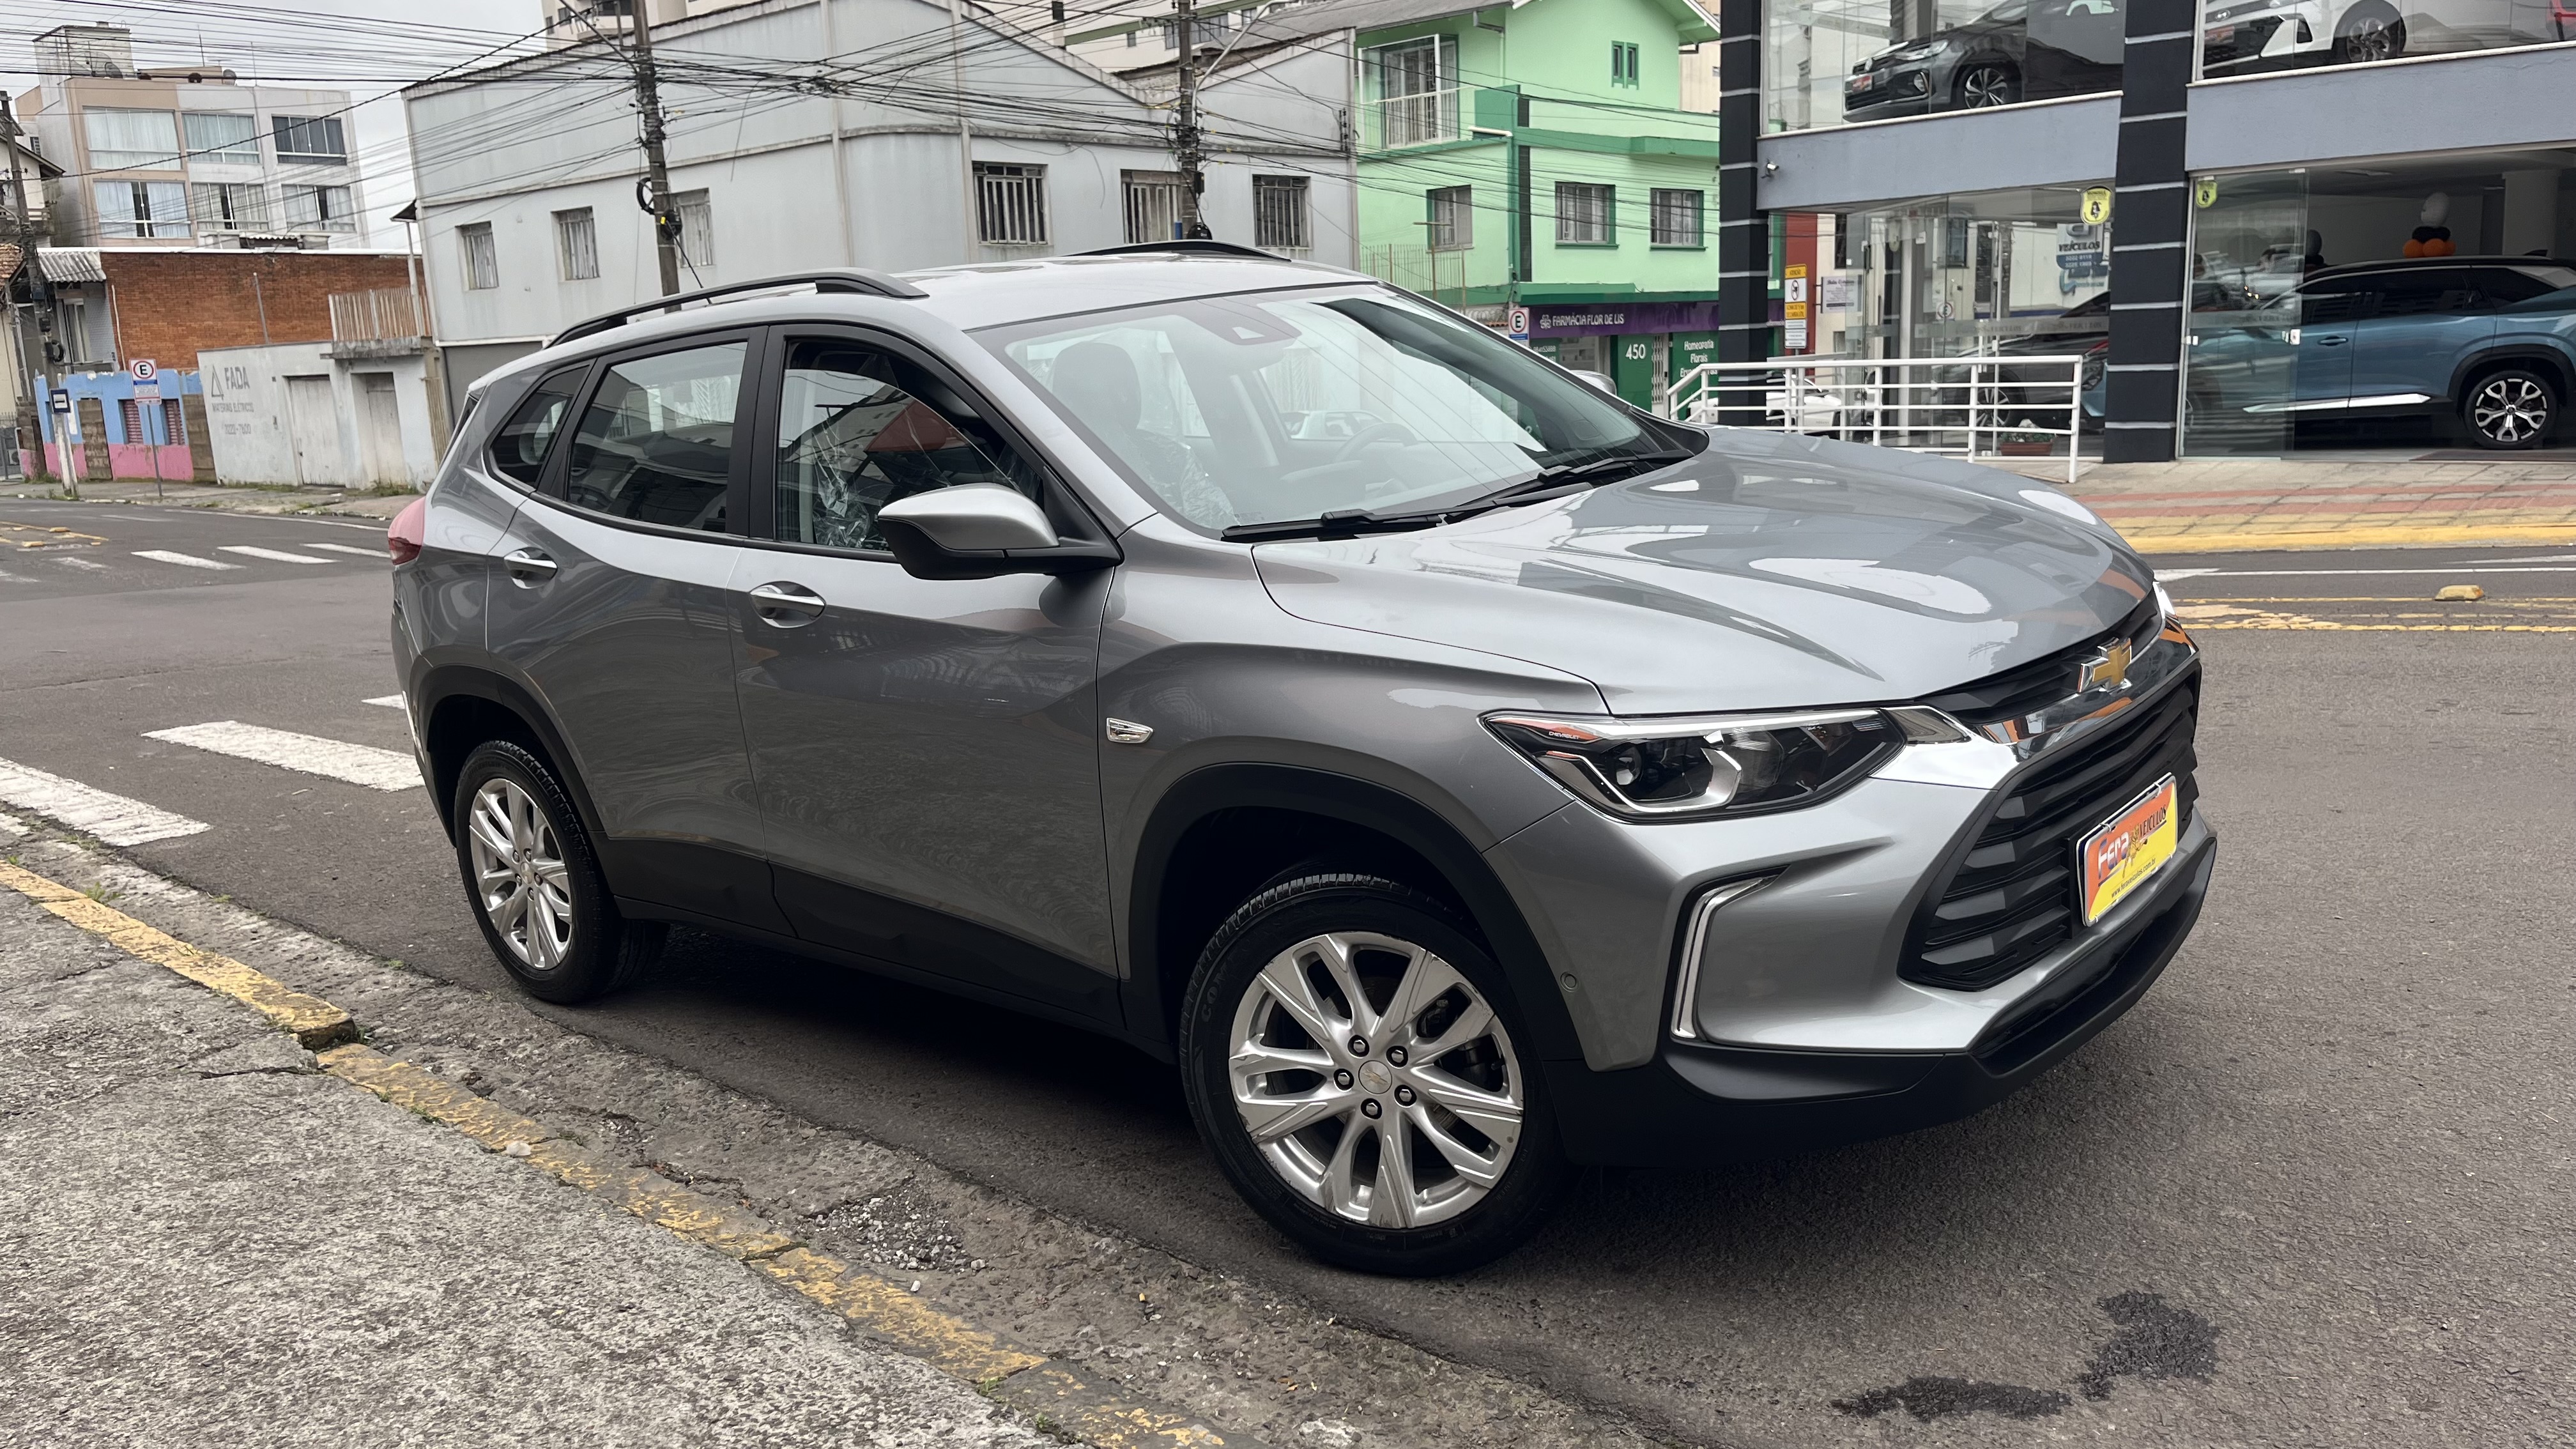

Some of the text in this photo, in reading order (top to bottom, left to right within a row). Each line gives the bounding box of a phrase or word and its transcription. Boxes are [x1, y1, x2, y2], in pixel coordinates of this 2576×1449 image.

[1515, 315, 1521, 328] E
[1552, 312, 1624, 326] FARMÁCIA FLOR DE LIS
[1625, 344, 1646, 360] 450
[139, 364, 148, 376] E
[224, 365, 250, 390] FADA
[1549, 731, 1580, 740] CHEVROLET
